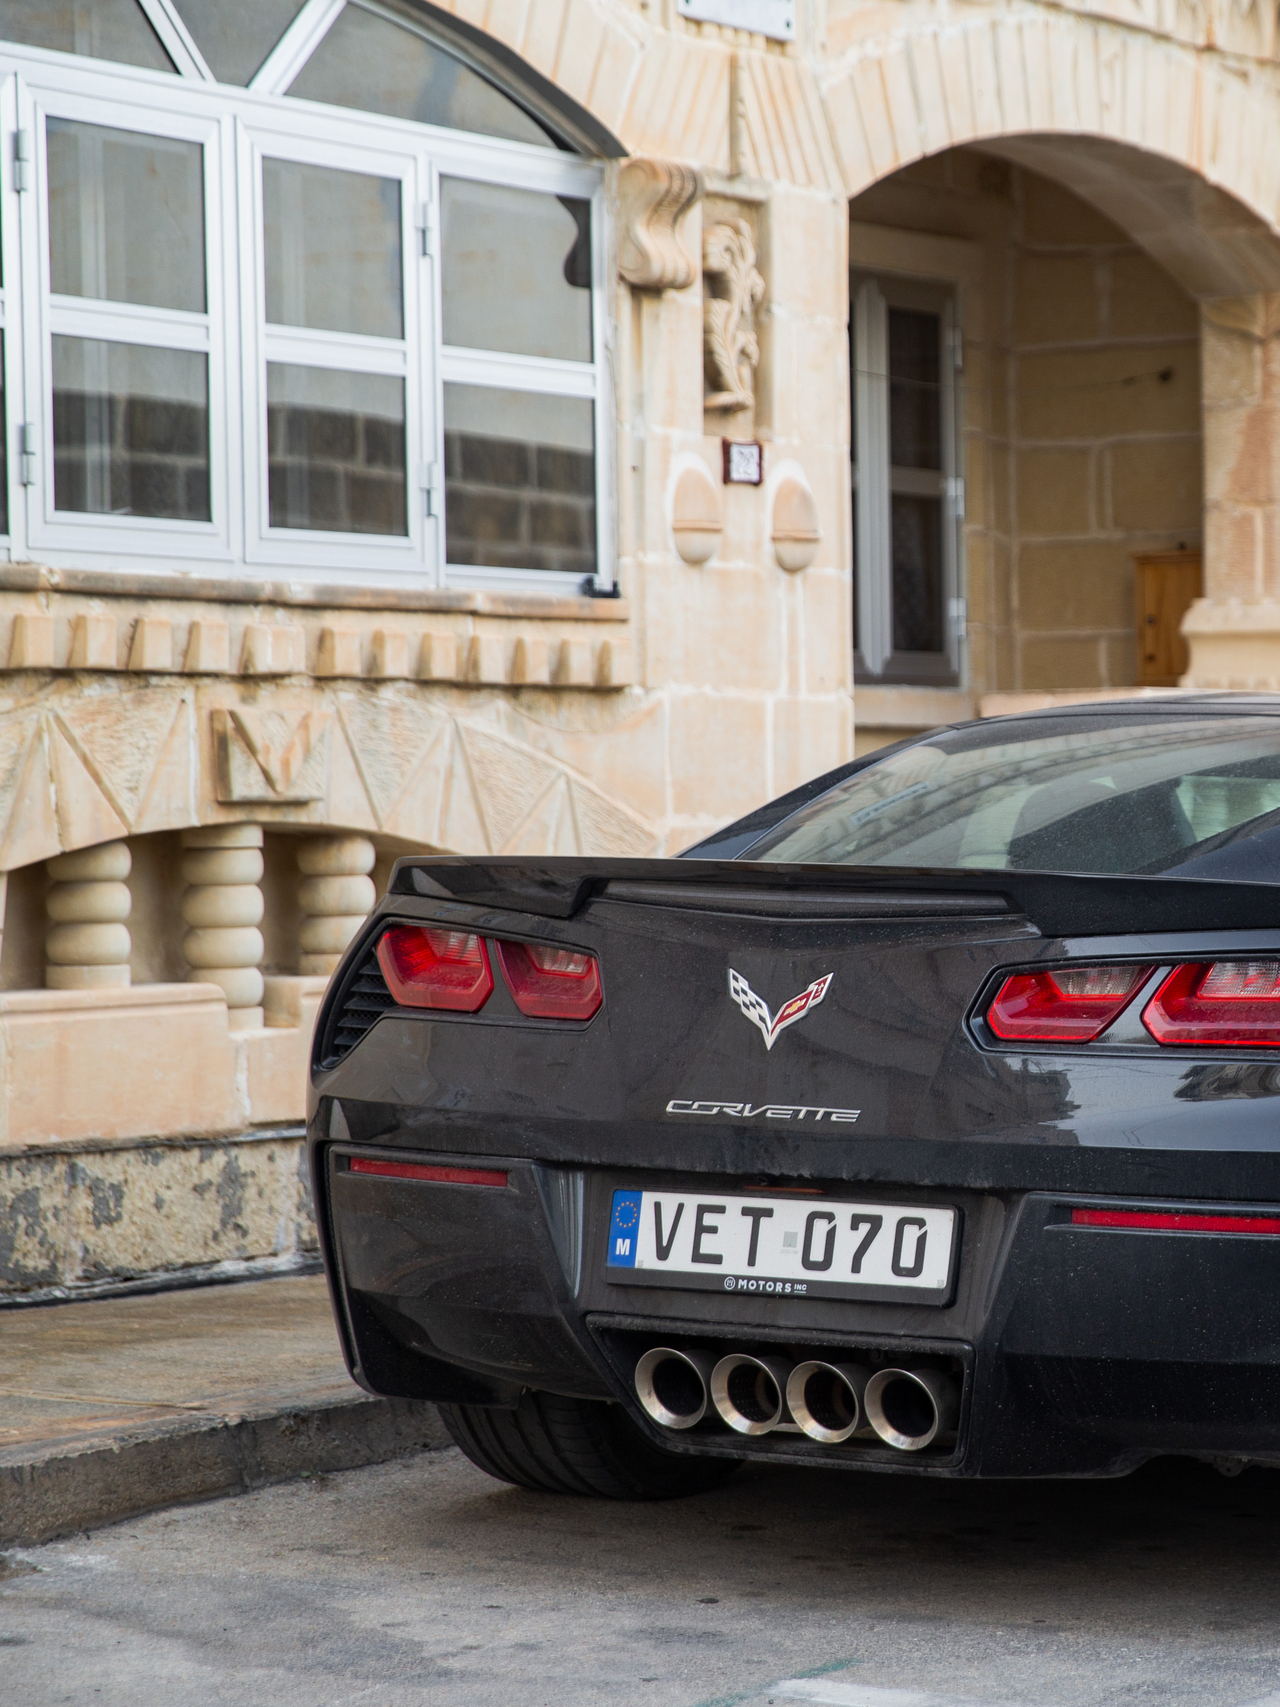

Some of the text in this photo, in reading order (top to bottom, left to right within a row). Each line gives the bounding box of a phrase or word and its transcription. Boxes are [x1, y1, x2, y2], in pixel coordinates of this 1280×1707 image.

[666, 1099, 862, 1123] CORVETTE
[615, 1200, 928, 1278] M VET 070
[738, 1278, 808, 1293] MOTORS INC
